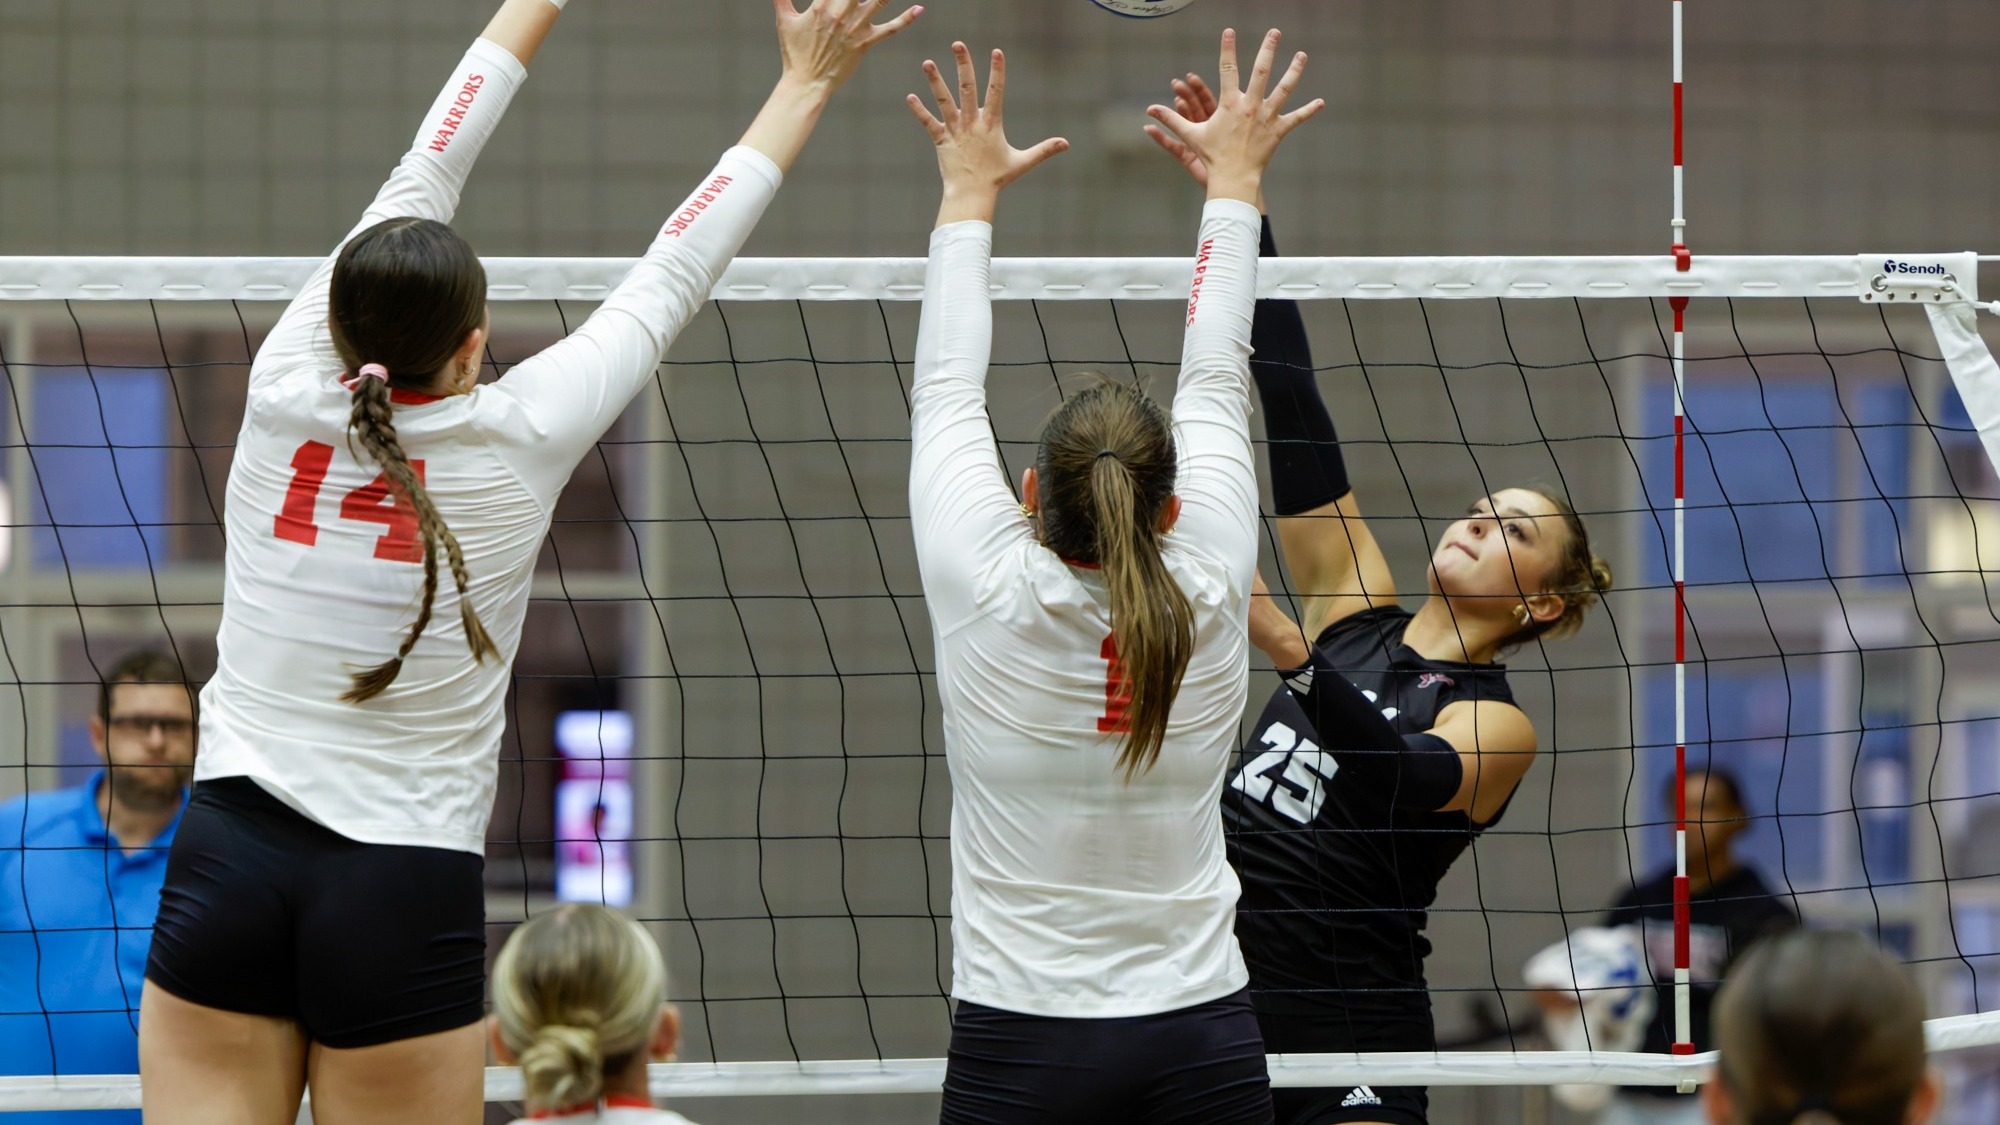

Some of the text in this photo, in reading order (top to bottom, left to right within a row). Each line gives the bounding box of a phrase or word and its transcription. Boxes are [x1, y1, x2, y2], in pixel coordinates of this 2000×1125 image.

[428, 73, 484, 153] WARRIORS
[664, 175, 733, 237] WARRIORS
[1186, 239, 1214, 328] WARRIORS
[1898, 262, 1945, 274] Senoh
[273, 439, 425, 564] 14
[1231, 721, 1339, 824] 25
[1341, 1096, 1382, 1107] adidas
